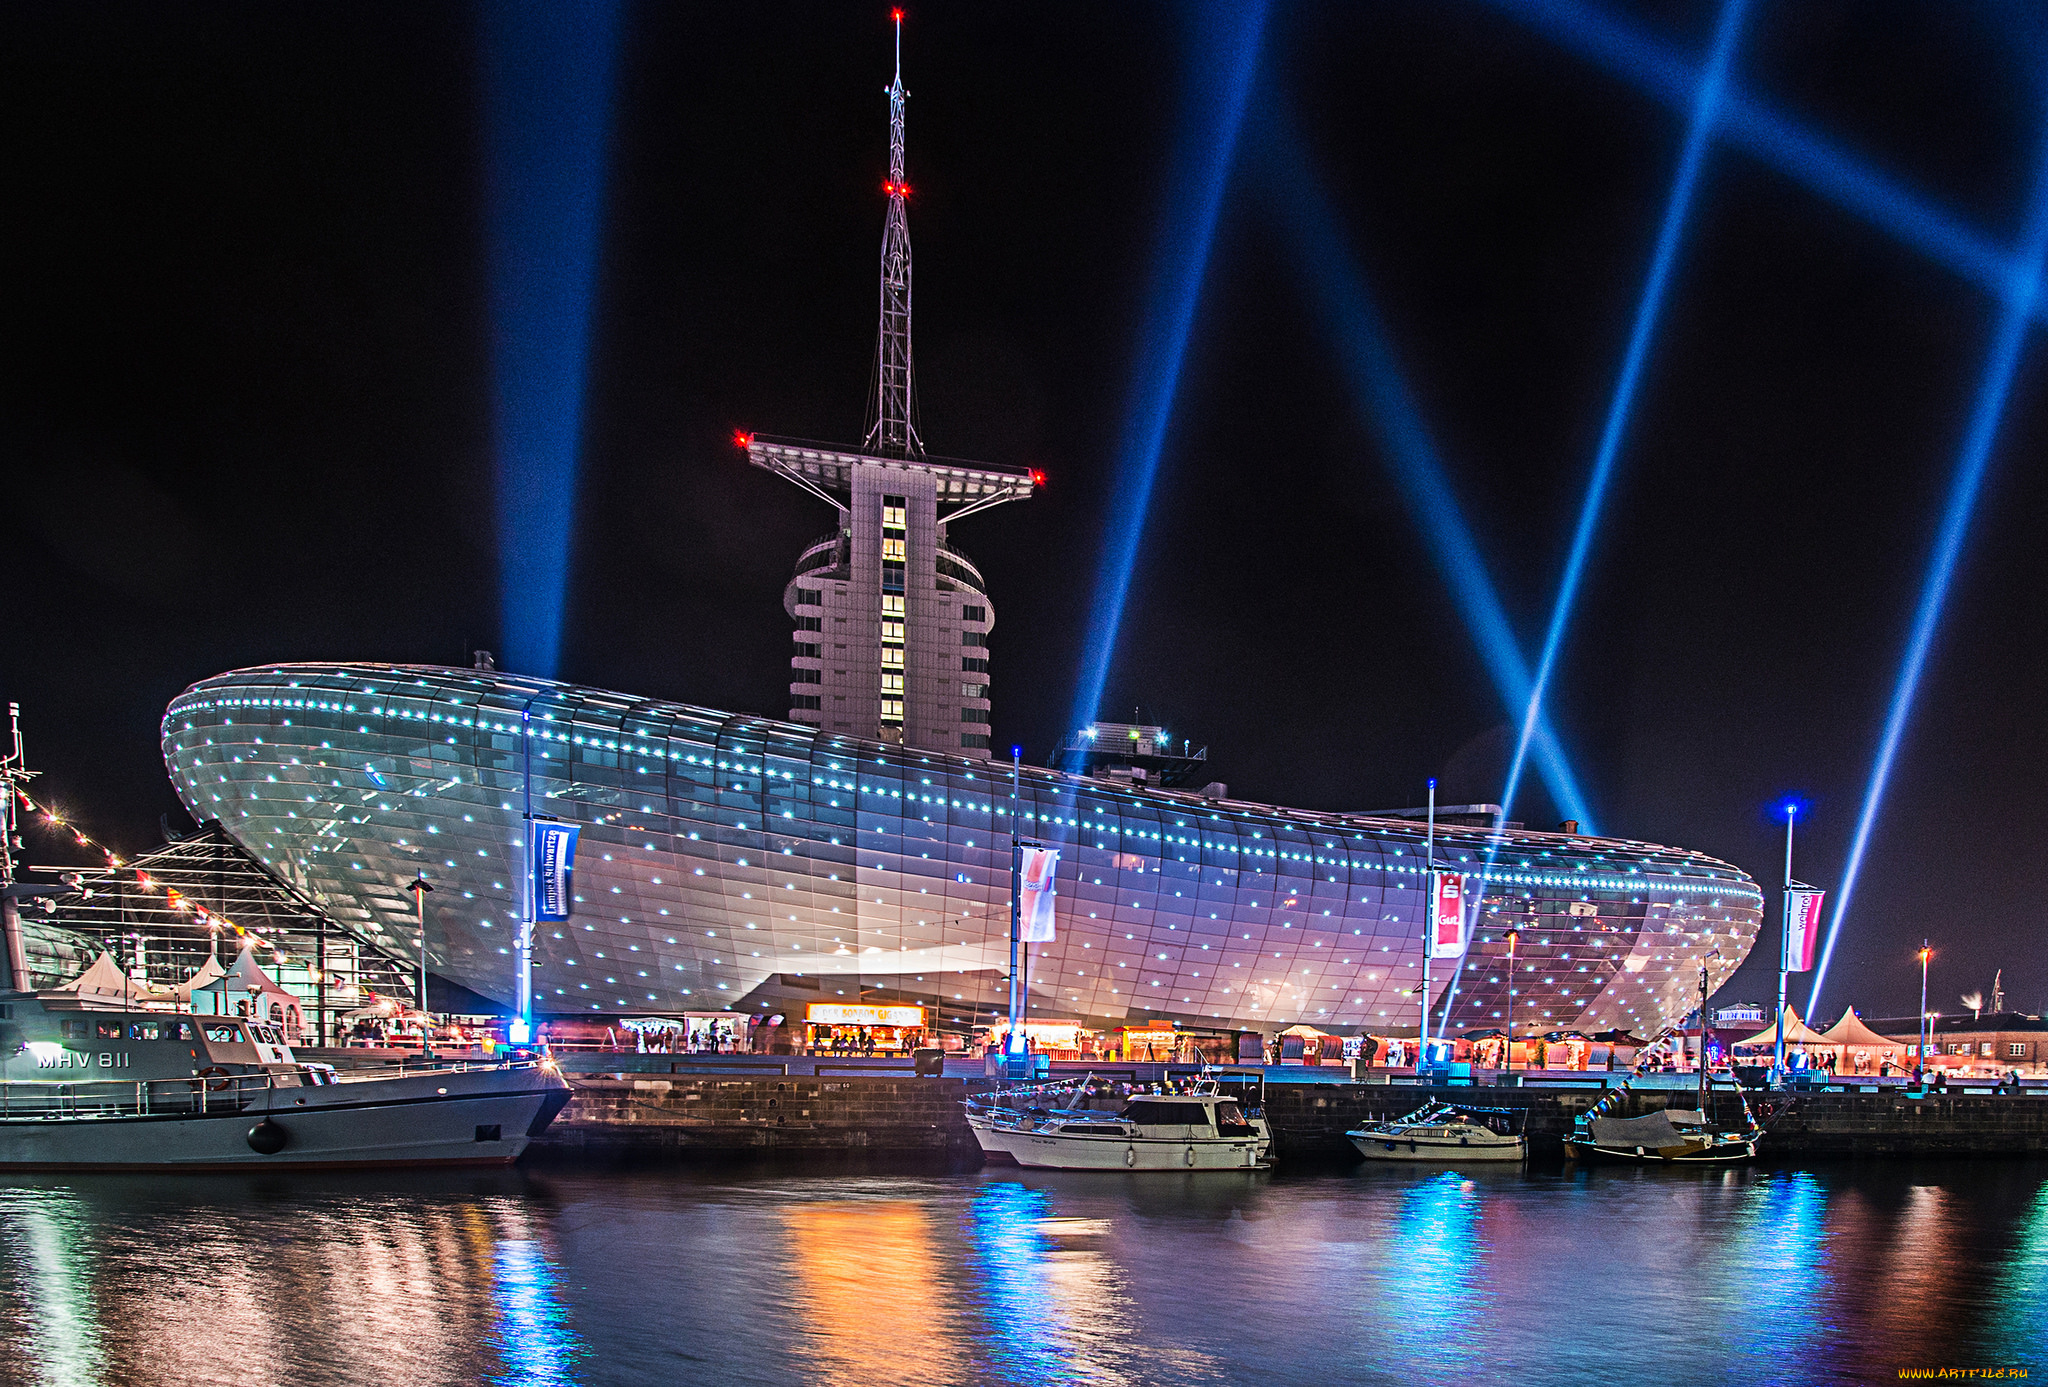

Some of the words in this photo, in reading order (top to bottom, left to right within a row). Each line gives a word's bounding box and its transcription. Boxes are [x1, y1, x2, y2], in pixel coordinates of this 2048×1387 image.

[544, 830, 559, 877] Schwartze
[1798, 895, 1811, 931] weinrot
[38, 1052, 91, 1068] MHV
[99, 1052, 130, 1068] 811
